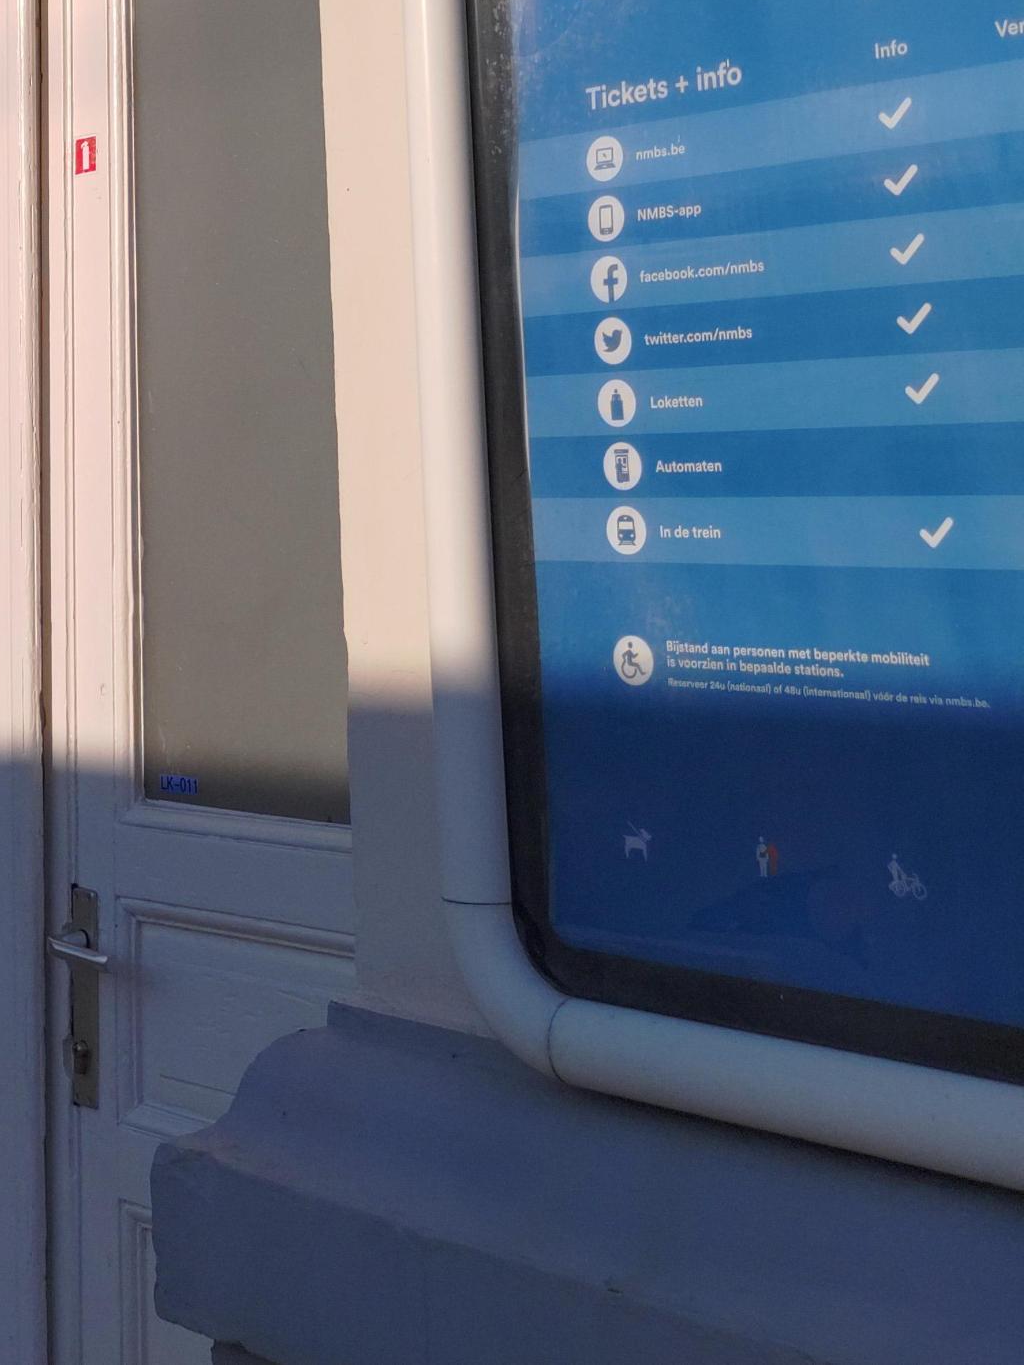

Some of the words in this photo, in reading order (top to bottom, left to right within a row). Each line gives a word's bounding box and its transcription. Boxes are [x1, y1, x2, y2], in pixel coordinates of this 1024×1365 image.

[875, 39, 908, 59] Info
[585, 78, 669, 110] Tickets
[696, 60, 742, 91] info
[636, 143, 686, 160] nmbs.be
[637, 205, 702, 221] NMBS-app
[640, 260, 764, 283] facebook.com/nmbs
[644, 326, 753, 346] twitter.com/nmbs
[650, 396, 703, 409] Loketten
[655, 460, 722, 473] Automaten
[660, 525, 671, 538] In
[674, 525, 689, 538] de
[692, 526, 721, 539] trein
[666, 640, 708, 655] Bijstand
[711, 645, 730, 655] aan
[733, 646, 785, 659] personen
[788, 648, 810, 660] met
[814, 648, 868, 663] beperkte
[871, 651, 930, 666] mobiliteit
[667, 655, 676, 668] is
[678, 657, 724, 671] voorzien
[726, 659, 737, 671] in
[739, 660, 791, 675] bepaalde
[794, 663, 844, 678] stations.
[667, 677, 708, 689] Reserveer
[160, 775, 198, 794] LK-011
